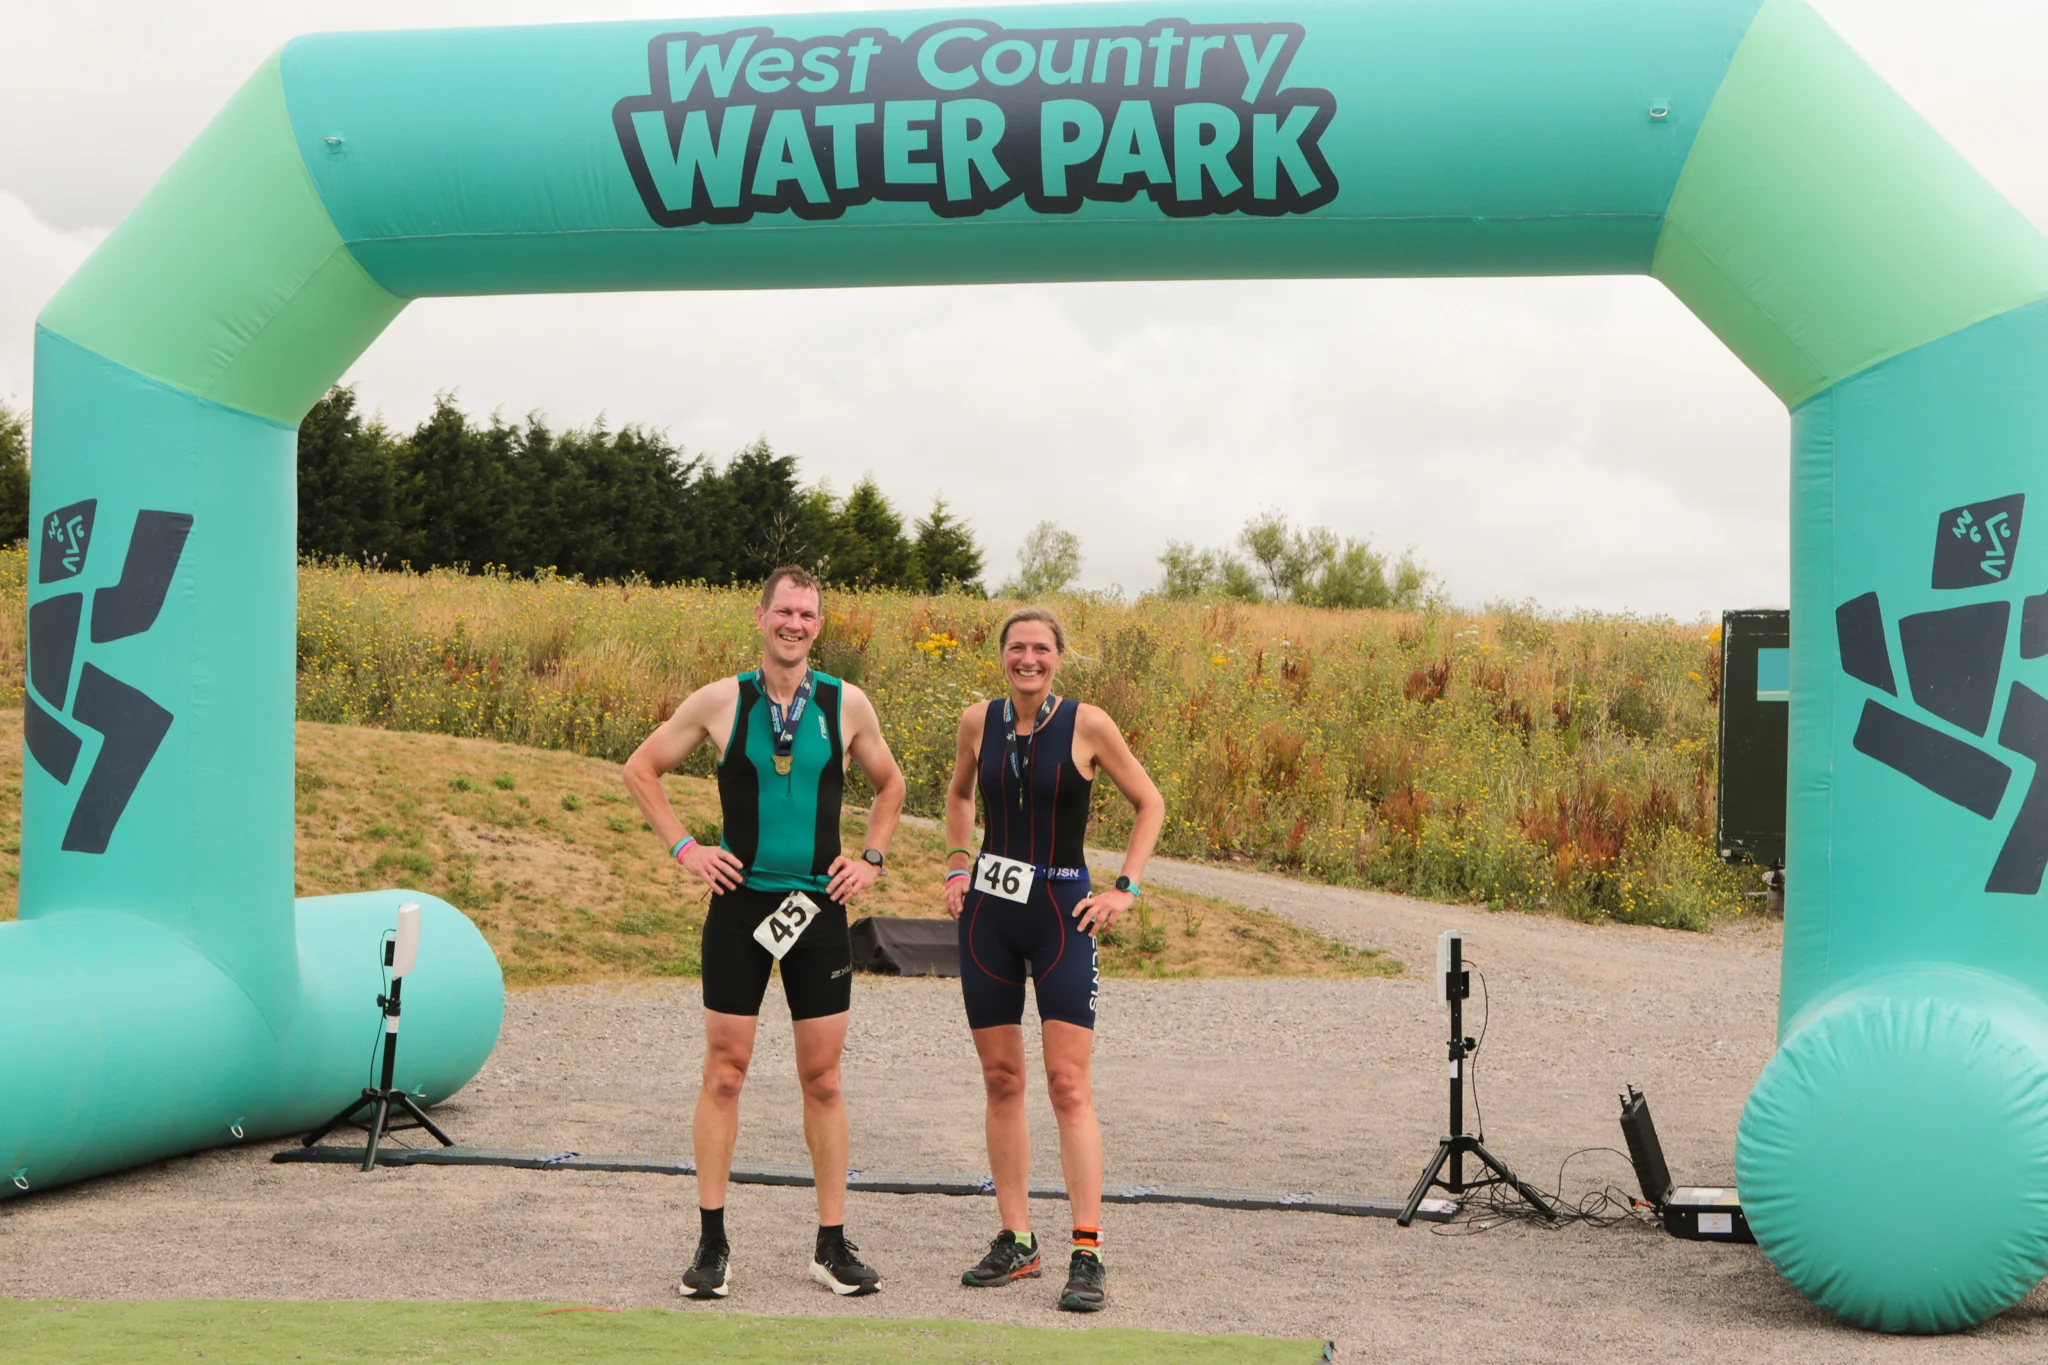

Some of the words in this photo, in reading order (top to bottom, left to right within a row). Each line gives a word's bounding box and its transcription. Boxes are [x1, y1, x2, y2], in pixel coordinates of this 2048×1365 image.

[666, 34, 882, 102] West
[917, 27, 1289, 104] Country
[631, 98, 1011, 211] WATER
[1041, 99, 1322, 201] PARK
[985, 861, 1023, 895] 46
[769, 900, 807, 943] 45
